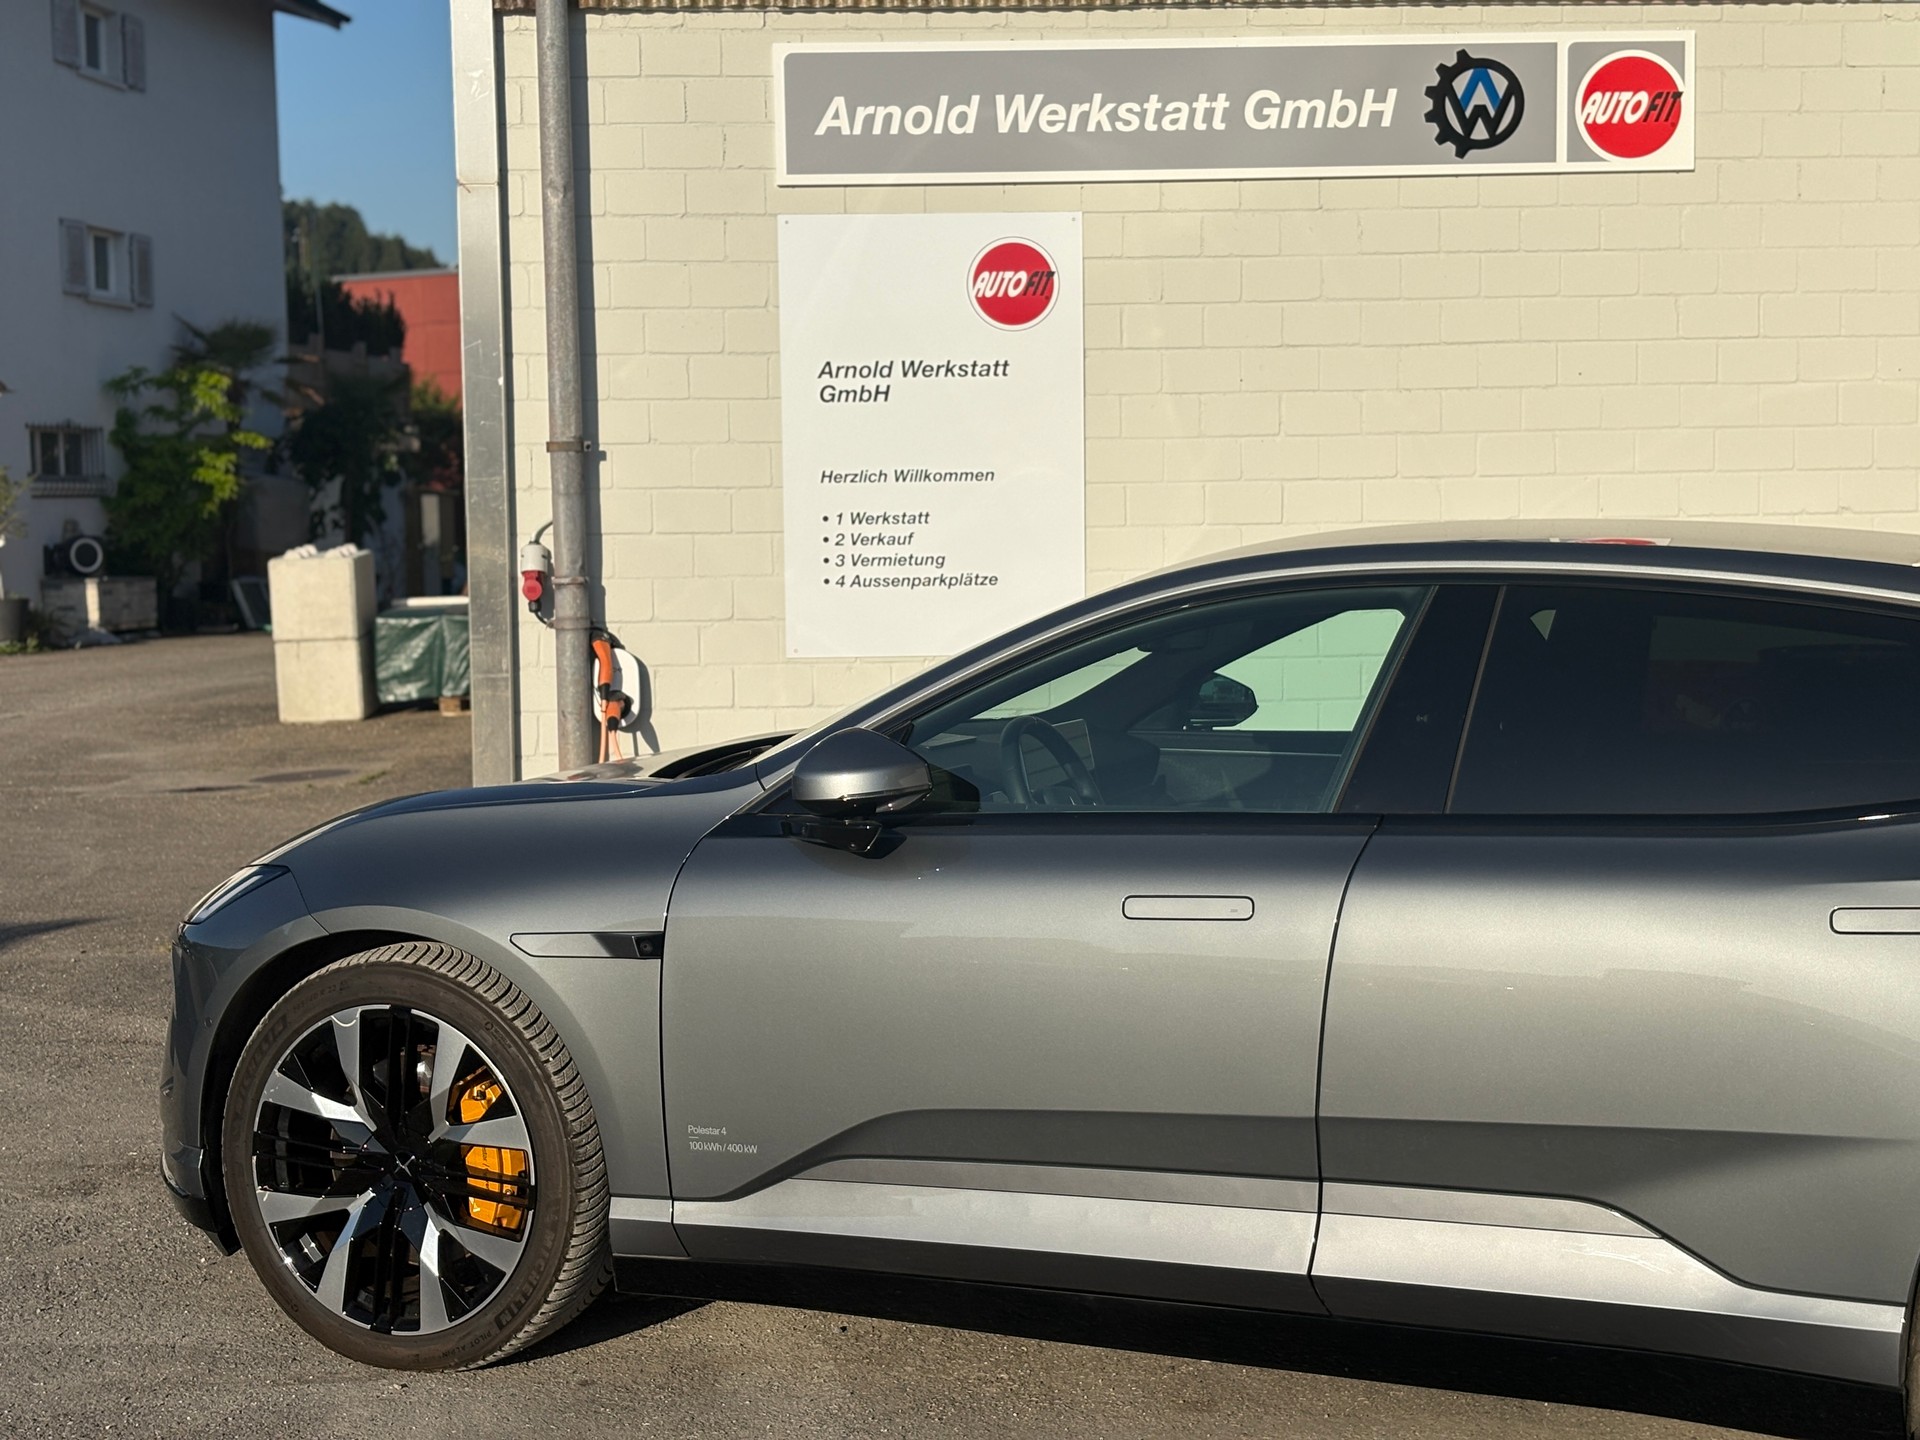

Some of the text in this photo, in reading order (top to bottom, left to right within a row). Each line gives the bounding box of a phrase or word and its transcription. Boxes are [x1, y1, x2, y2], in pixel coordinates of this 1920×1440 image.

[814, 88, 1398, 136] Arnold Werkstatt GmbH
[817, 359, 1010, 379] Arnold Werkstatt
[819, 383, 891, 403] GmbH
[820, 468, 996, 484] Herzlich Willkommen
[835, 511, 930, 526] 1 Werkstatt
[834, 532, 915, 546] 2 Verkauf
[834, 553, 946, 569] 3 Vermietung
[834, 573, 999, 590] 4 Aussenparkplätze
[687, 1124, 727, 1136] Polestar 4
[689, 1141, 703, 1150] 100
[727, 1143, 743, 1153] 400
[498, 1229, 556, 1327] MICHELIN
